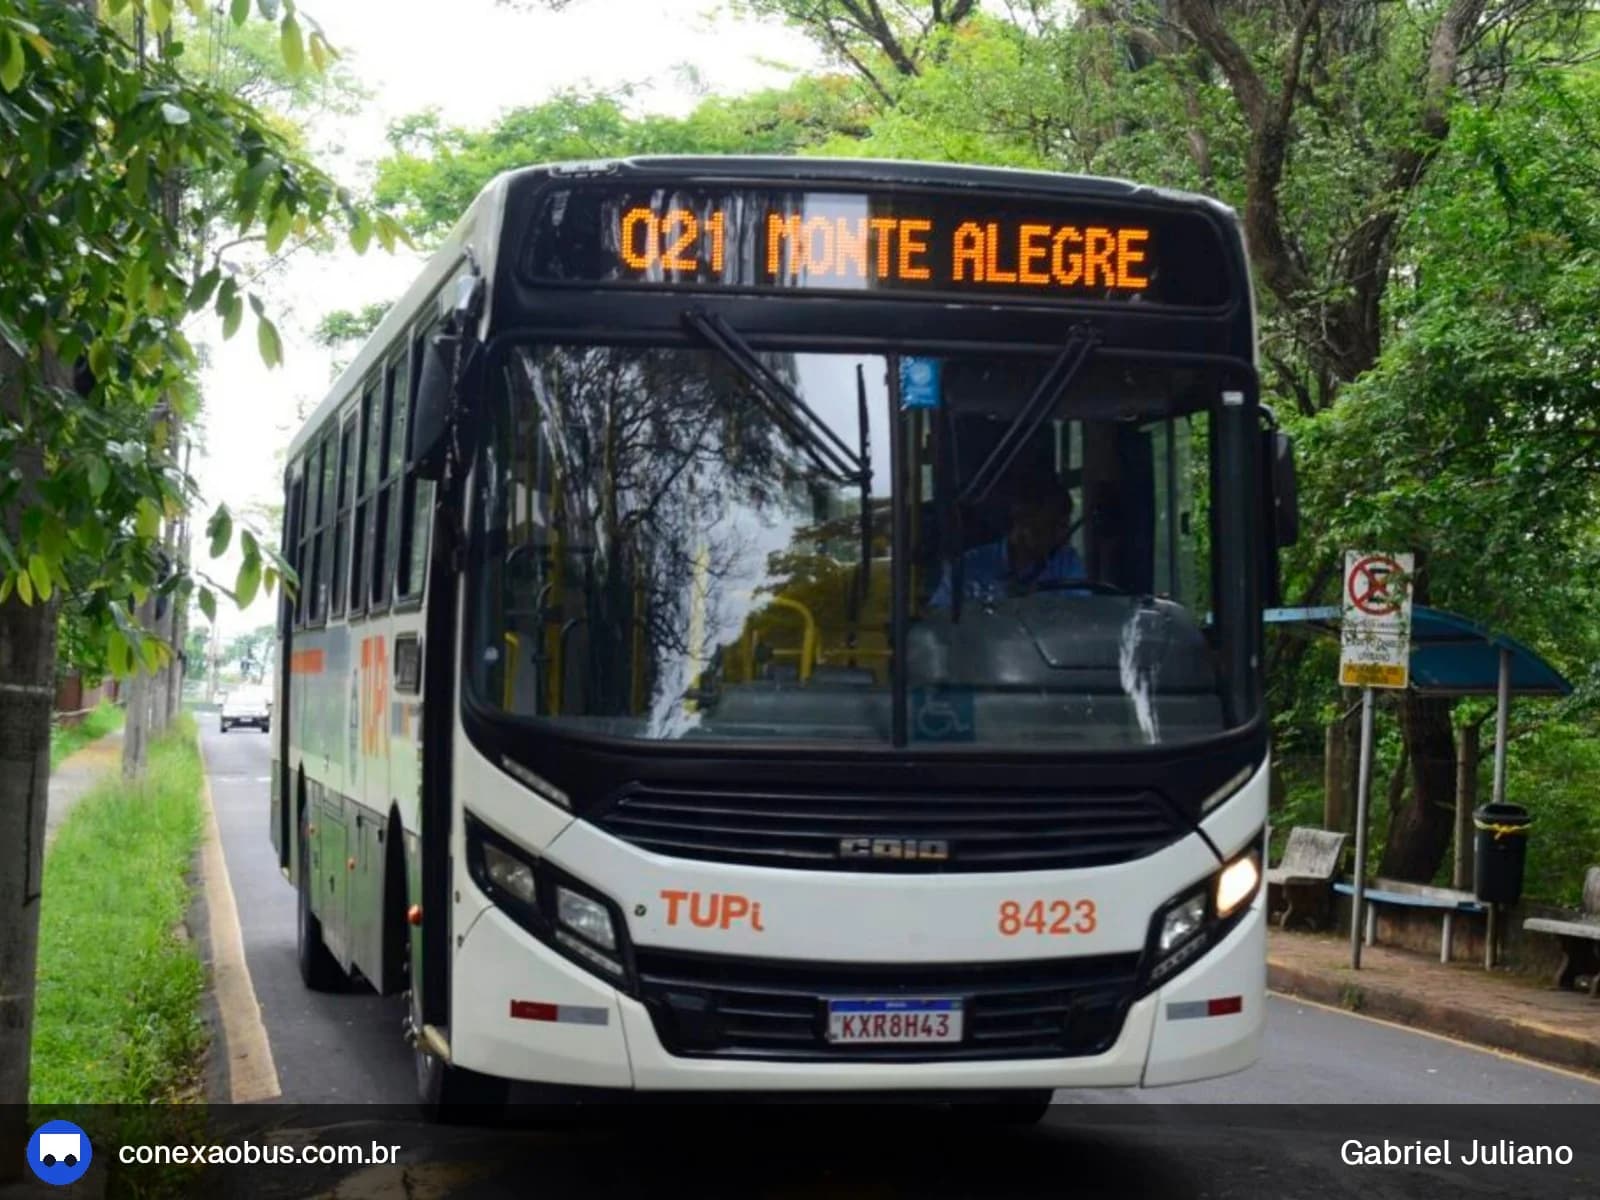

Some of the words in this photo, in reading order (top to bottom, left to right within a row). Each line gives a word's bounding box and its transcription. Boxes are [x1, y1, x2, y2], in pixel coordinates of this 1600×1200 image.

[621, 207, 725, 272] 021
[767, 212, 931, 280] MONTE
[952, 221, 1149, 288] ALEGRE
[999, 899, 1096, 935] 8423
[841, 1013, 950, 1038] KXR8H43
